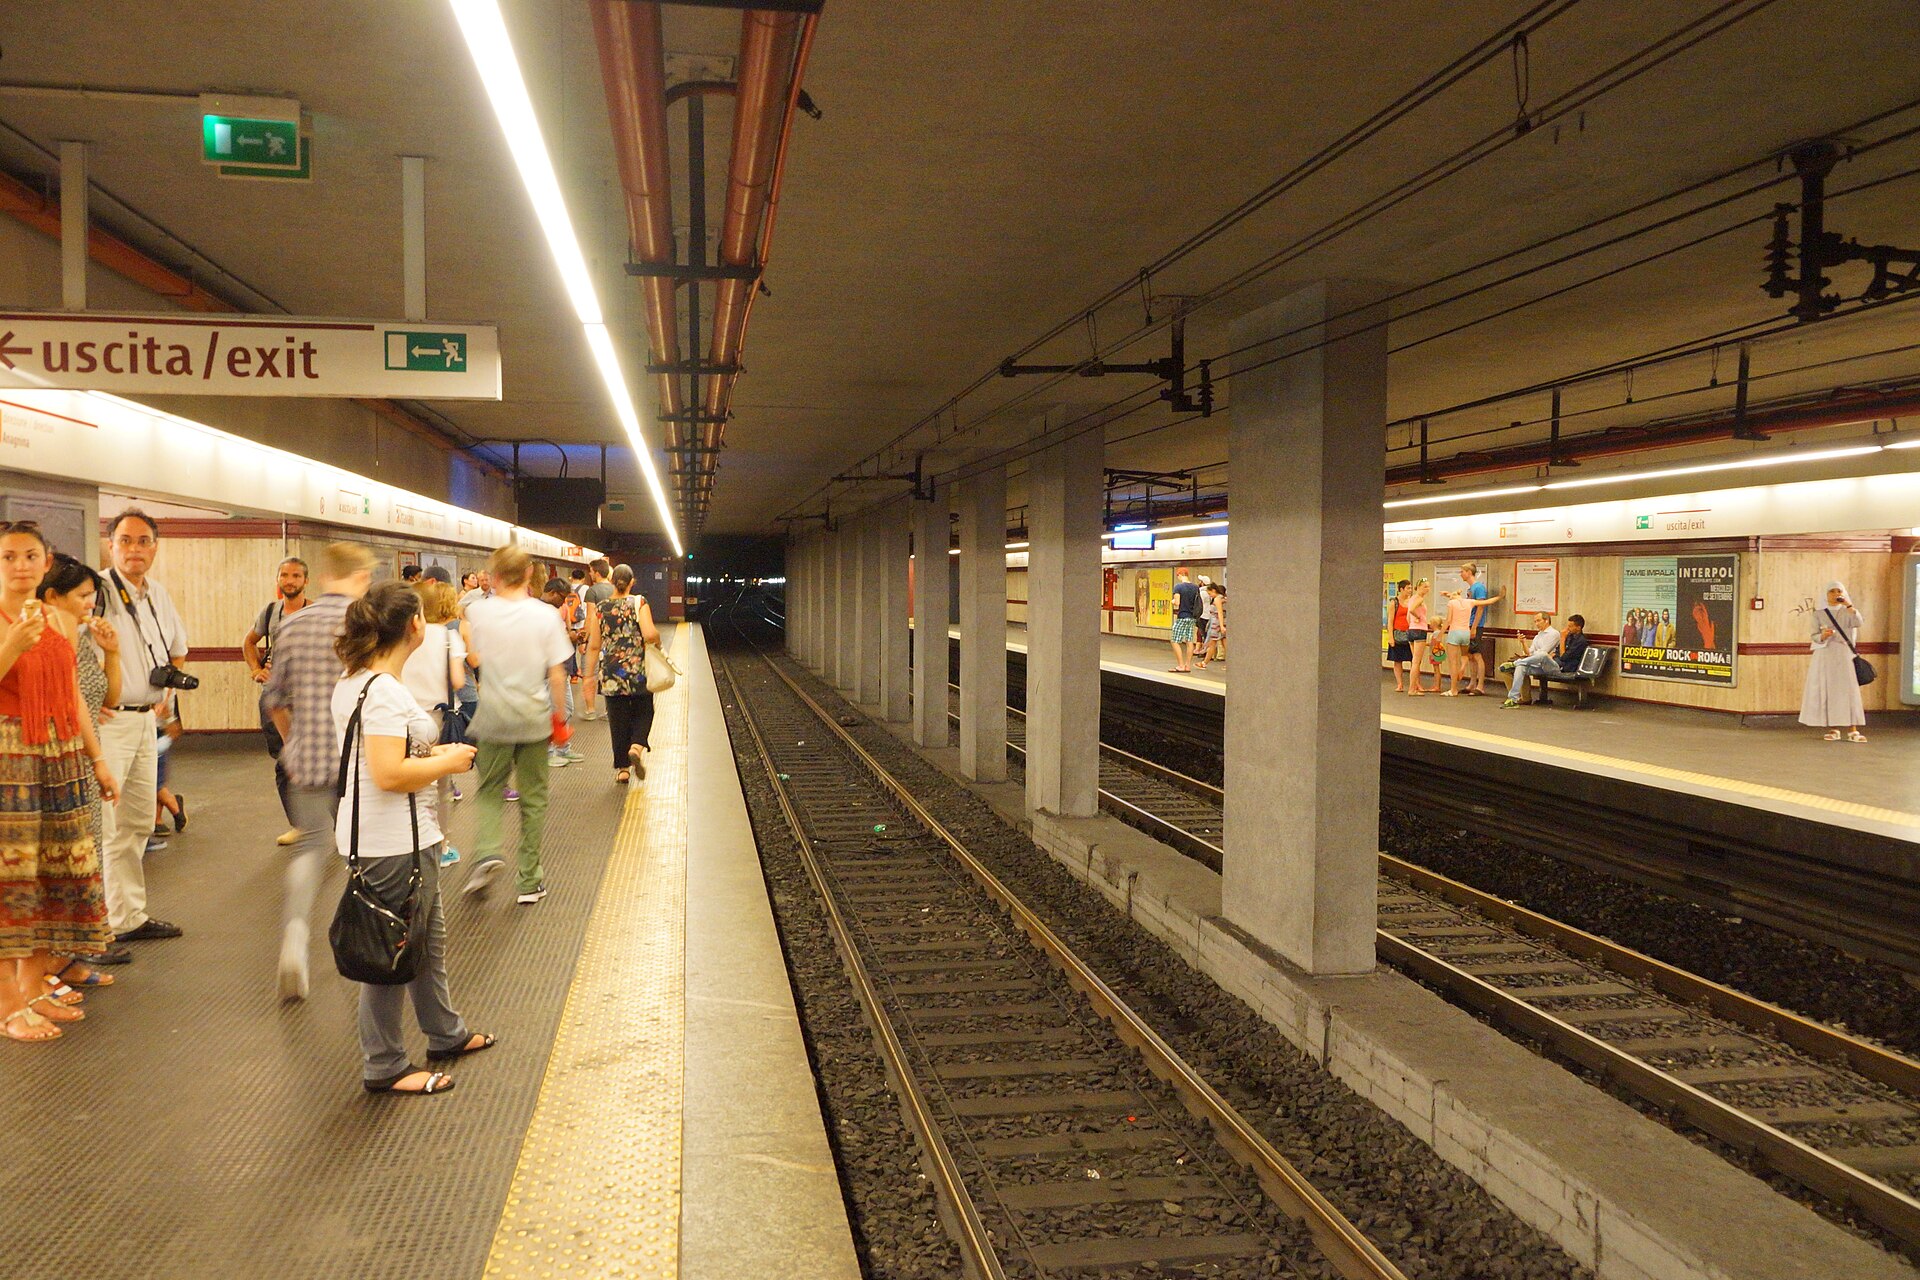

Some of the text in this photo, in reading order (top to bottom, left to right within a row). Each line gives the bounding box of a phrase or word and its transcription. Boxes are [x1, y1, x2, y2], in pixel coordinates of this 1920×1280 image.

[42, 331, 319, 380] uscita/exit
[1666, 518, 1705, 531] uscita/exit
[1626, 569, 1675, 577] TAME IMPALA
[1679, 567, 1733, 578] INTERPOL
[1624, 646, 1665, 660] postepay
[1666, 649, 1691, 661] ROCK
[1698, 651, 1725, 664] ROMA
